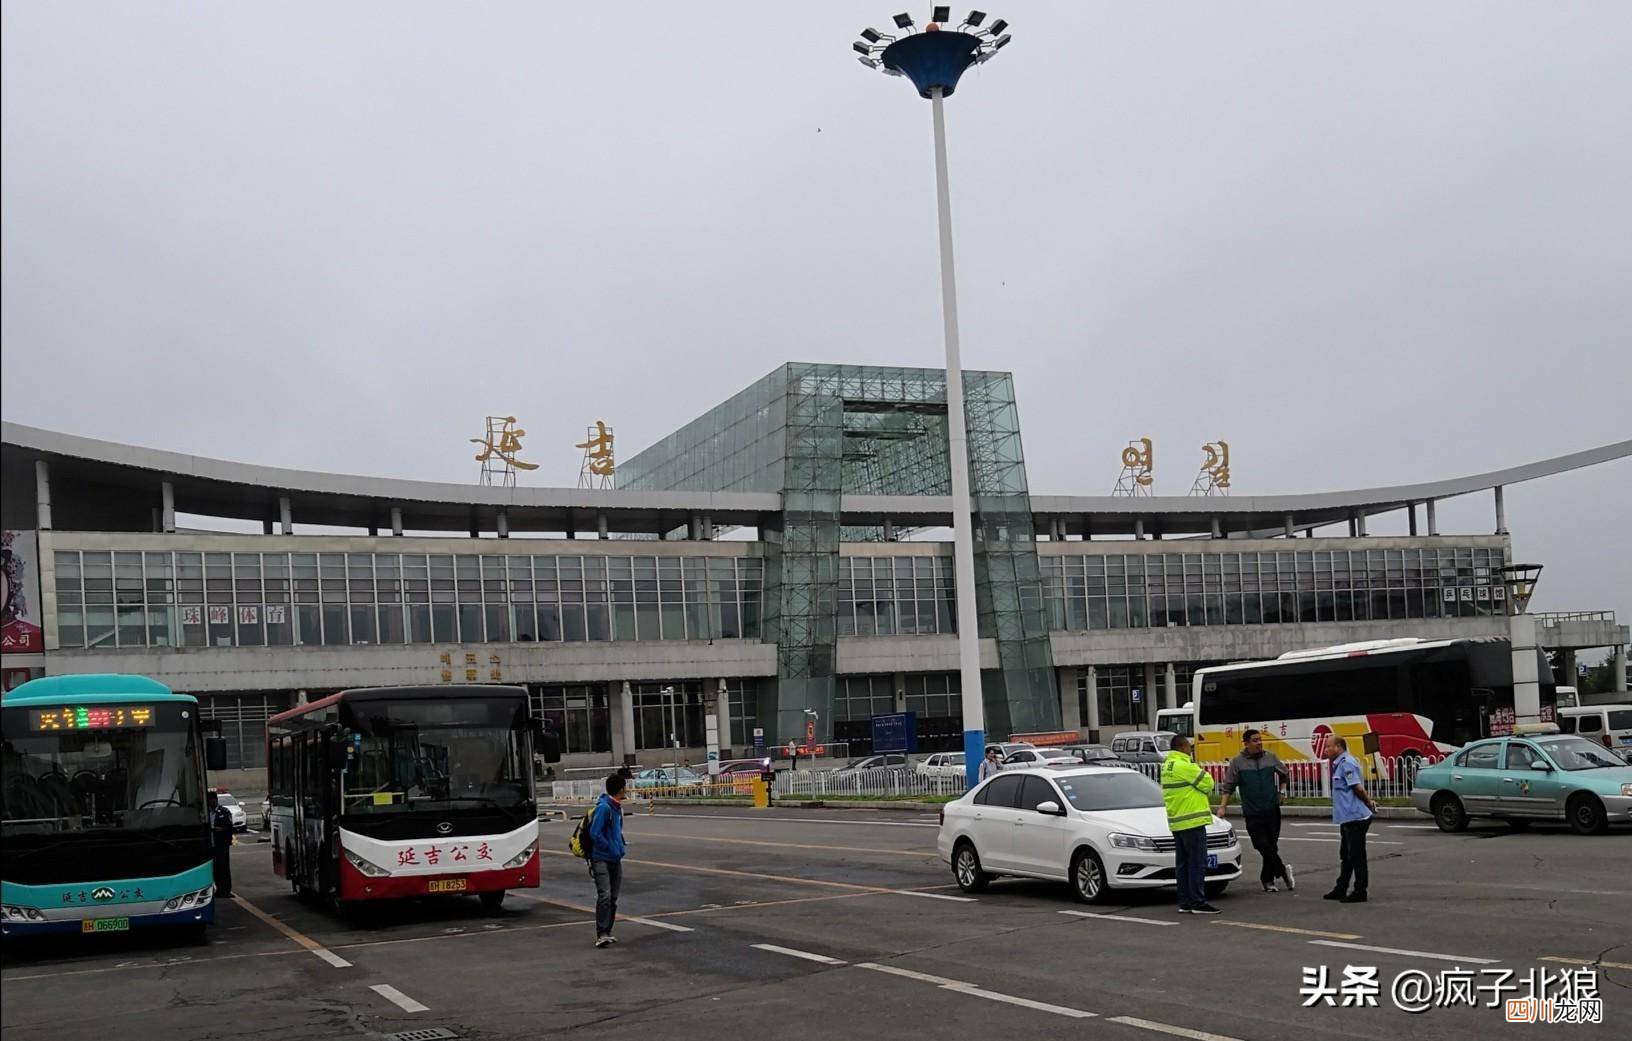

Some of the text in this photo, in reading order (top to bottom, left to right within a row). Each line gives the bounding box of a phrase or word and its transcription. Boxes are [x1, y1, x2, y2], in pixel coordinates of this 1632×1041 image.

[470, 416, 614, 475] 延吉
[1122, 438, 1230, 487] 연길
[1445, 588, 1504, 599] 乒乓球馆
[184, 606, 283, 623] 珠峰体育
[2, 634, 30, 647] 公司
[397, 843, 493, 866] 延吉公交
